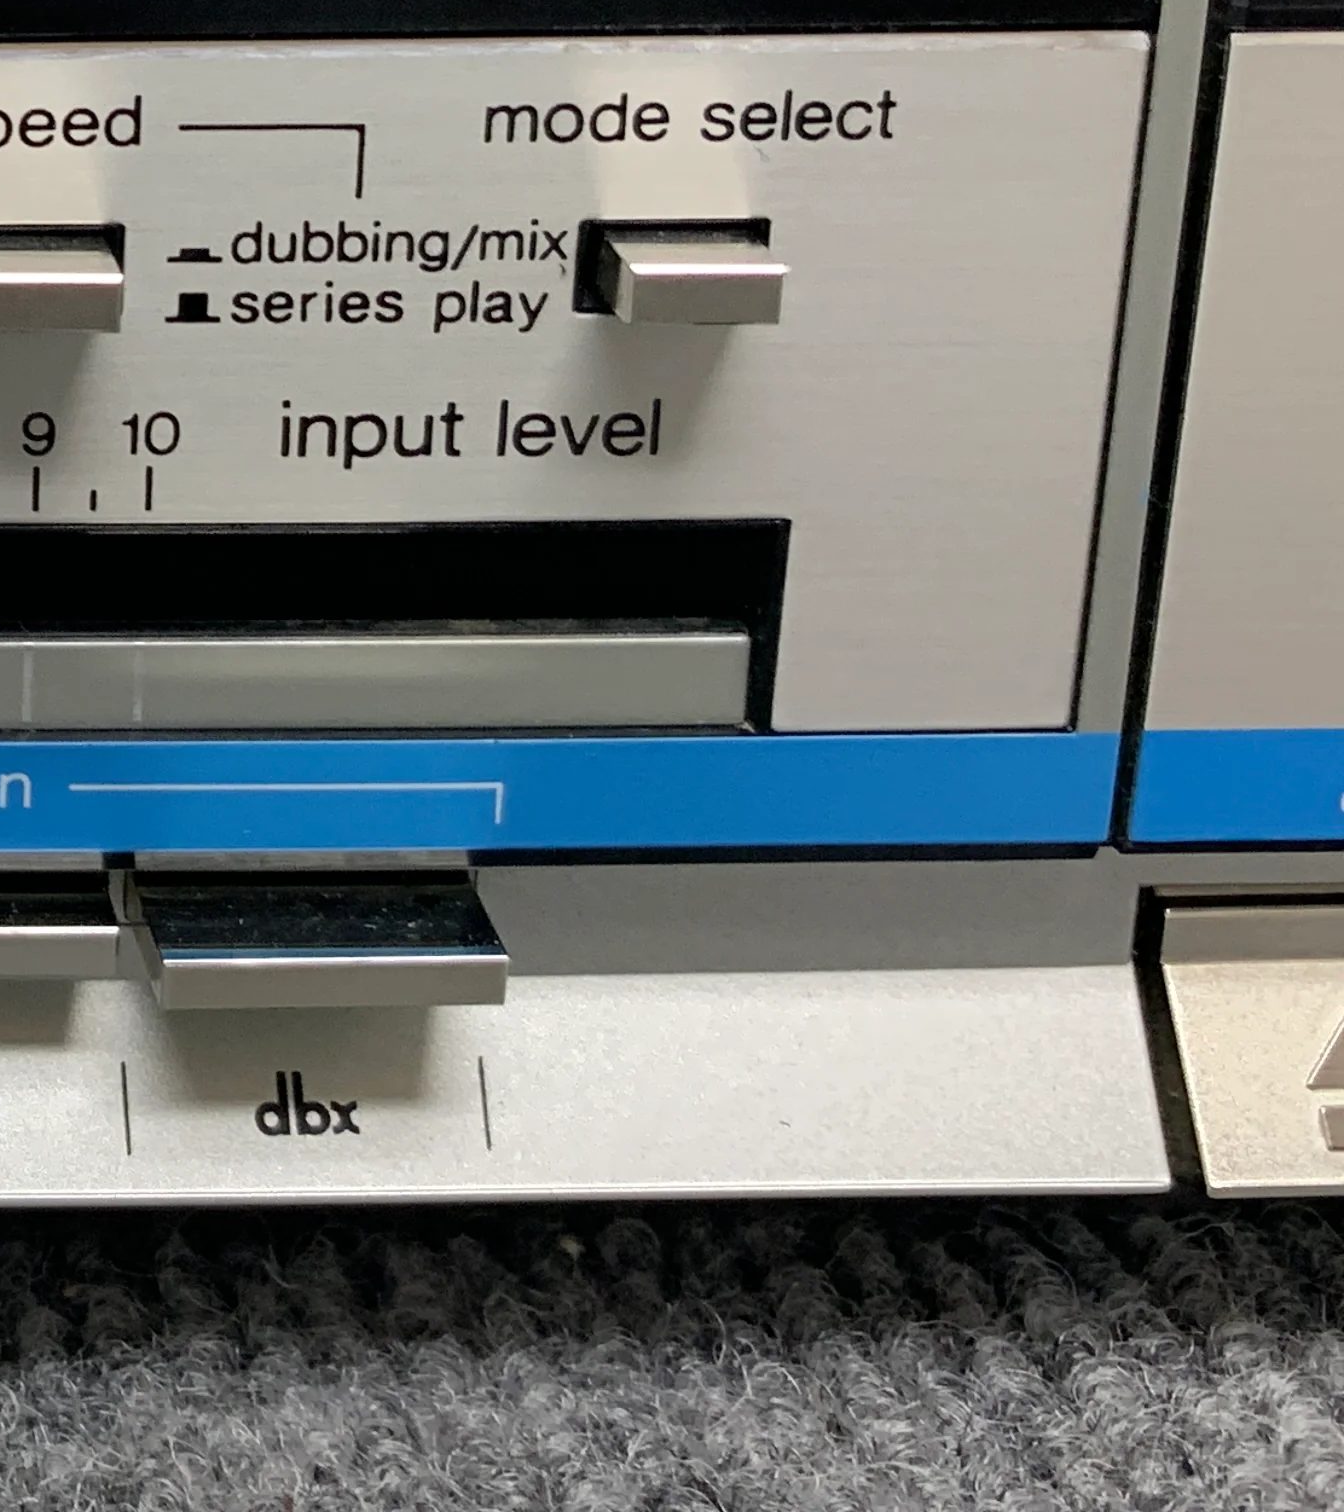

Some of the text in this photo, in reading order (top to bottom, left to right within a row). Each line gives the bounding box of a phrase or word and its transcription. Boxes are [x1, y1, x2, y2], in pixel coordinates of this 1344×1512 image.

[483, 88, 898, 145] mode select
[230, 217, 569, 274] dubbing/mix
[229, 279, 550, 335] series play
[21, 410, 57, 458] 9
[121, 410, 182, 457] 10
[279, 397, 663, 471] input level
[253, 1070, 362, 1138] dbx
